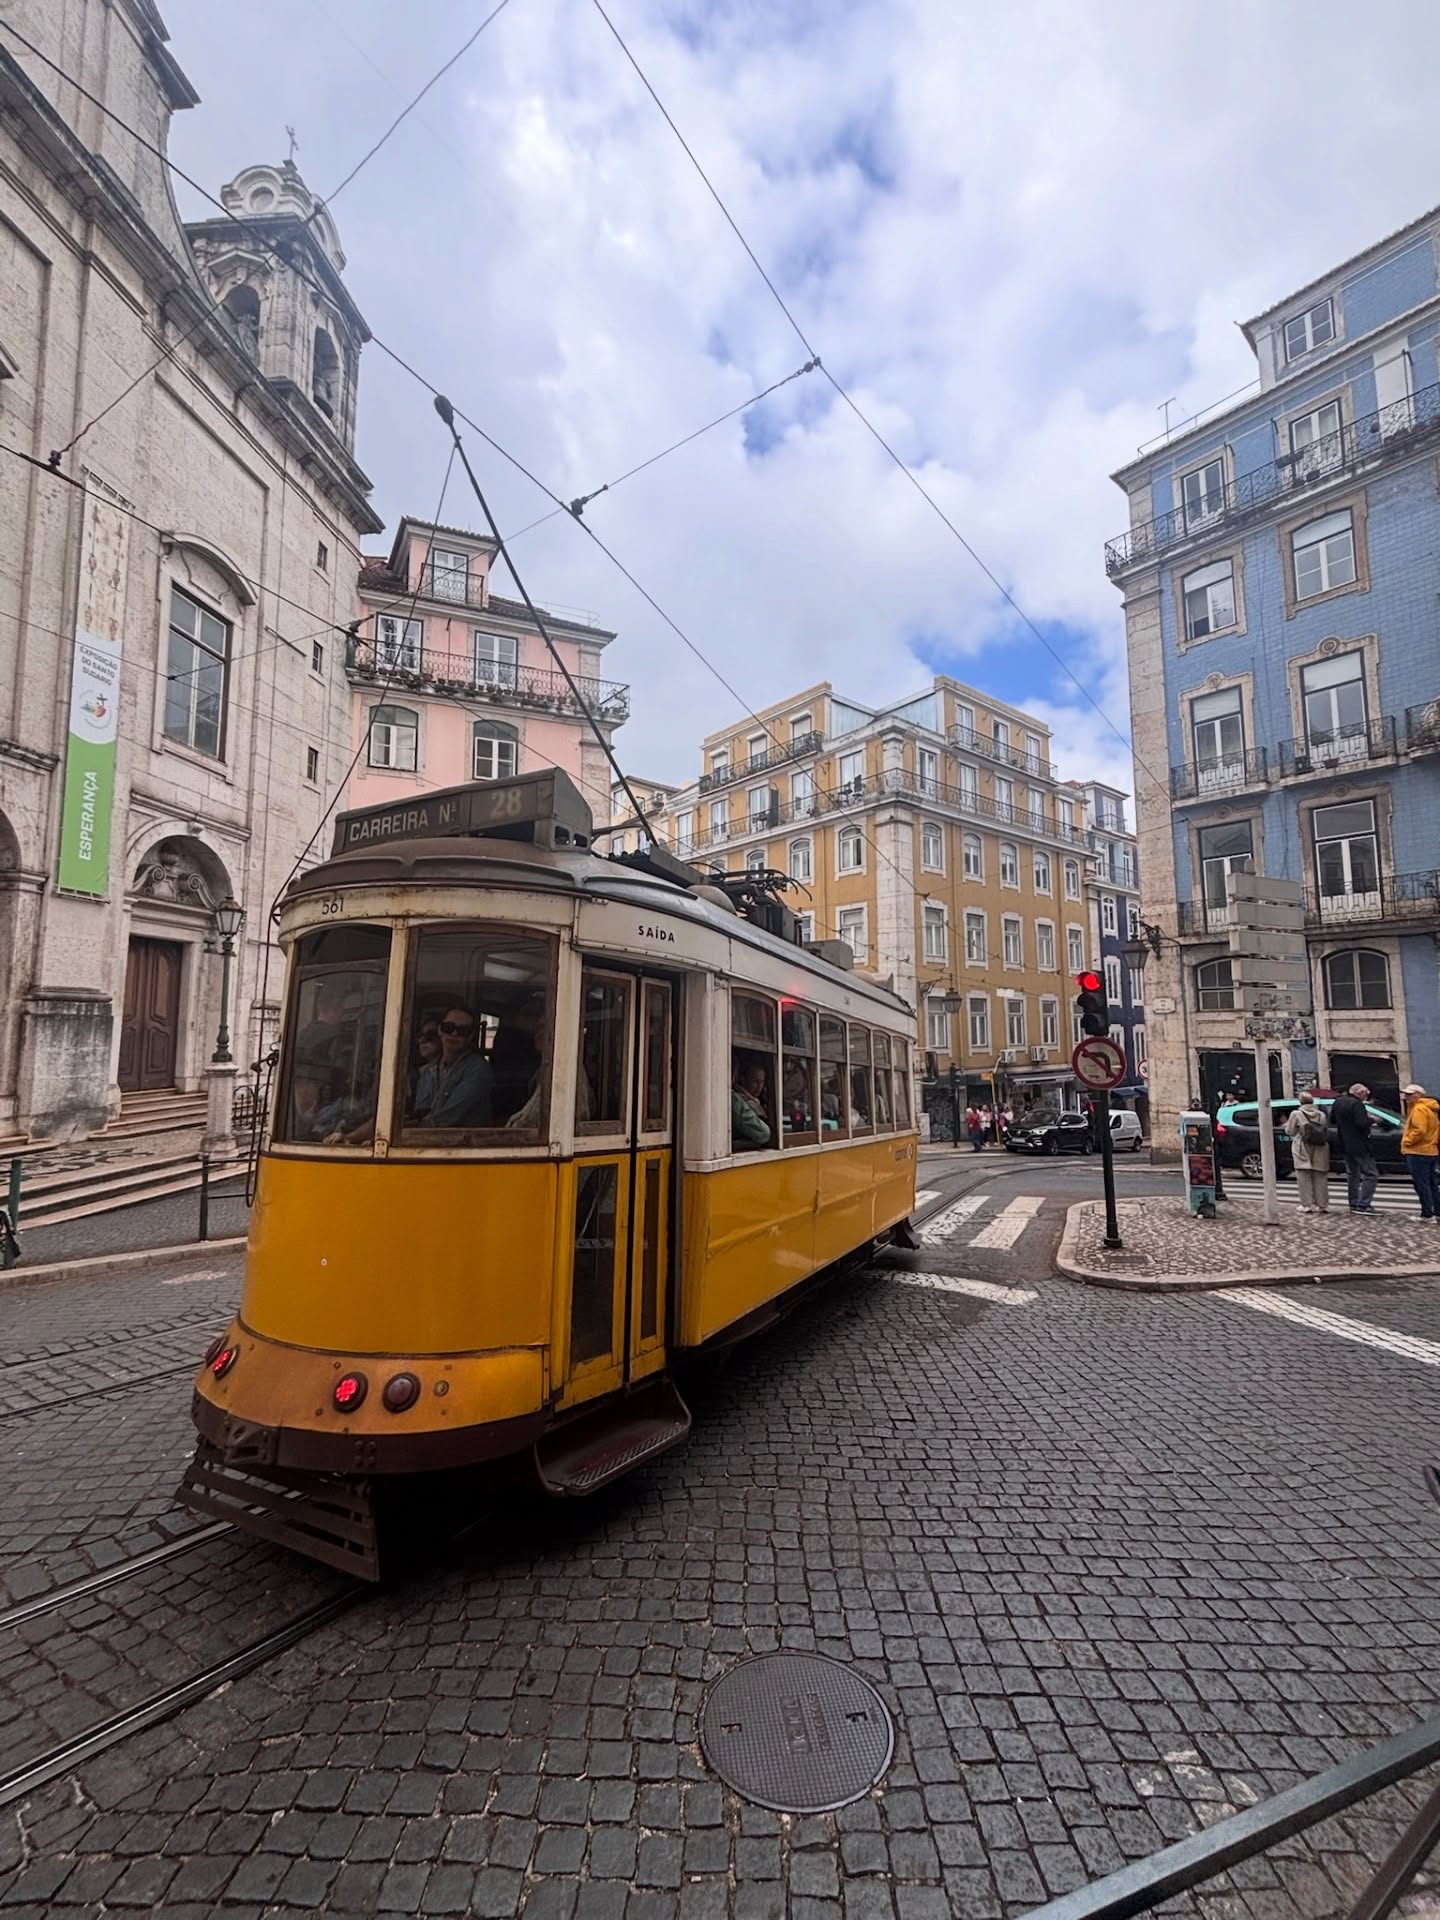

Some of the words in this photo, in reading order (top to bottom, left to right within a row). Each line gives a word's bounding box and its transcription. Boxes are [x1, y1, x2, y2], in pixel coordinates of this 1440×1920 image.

[80, 646, 118, 670] EXPOSIÇÃO
[81, 656, 91, 666] DO
[93, 662, 115, 678] SANTO
[78, 771, 98, 861] ESPERANÇA
[350, 809, 429, 841] CARREIRA
[490, 789, 522, 819] 28
[321, 895, 344, 915] 561
[638, 925, 675, 943] SAÍDA
